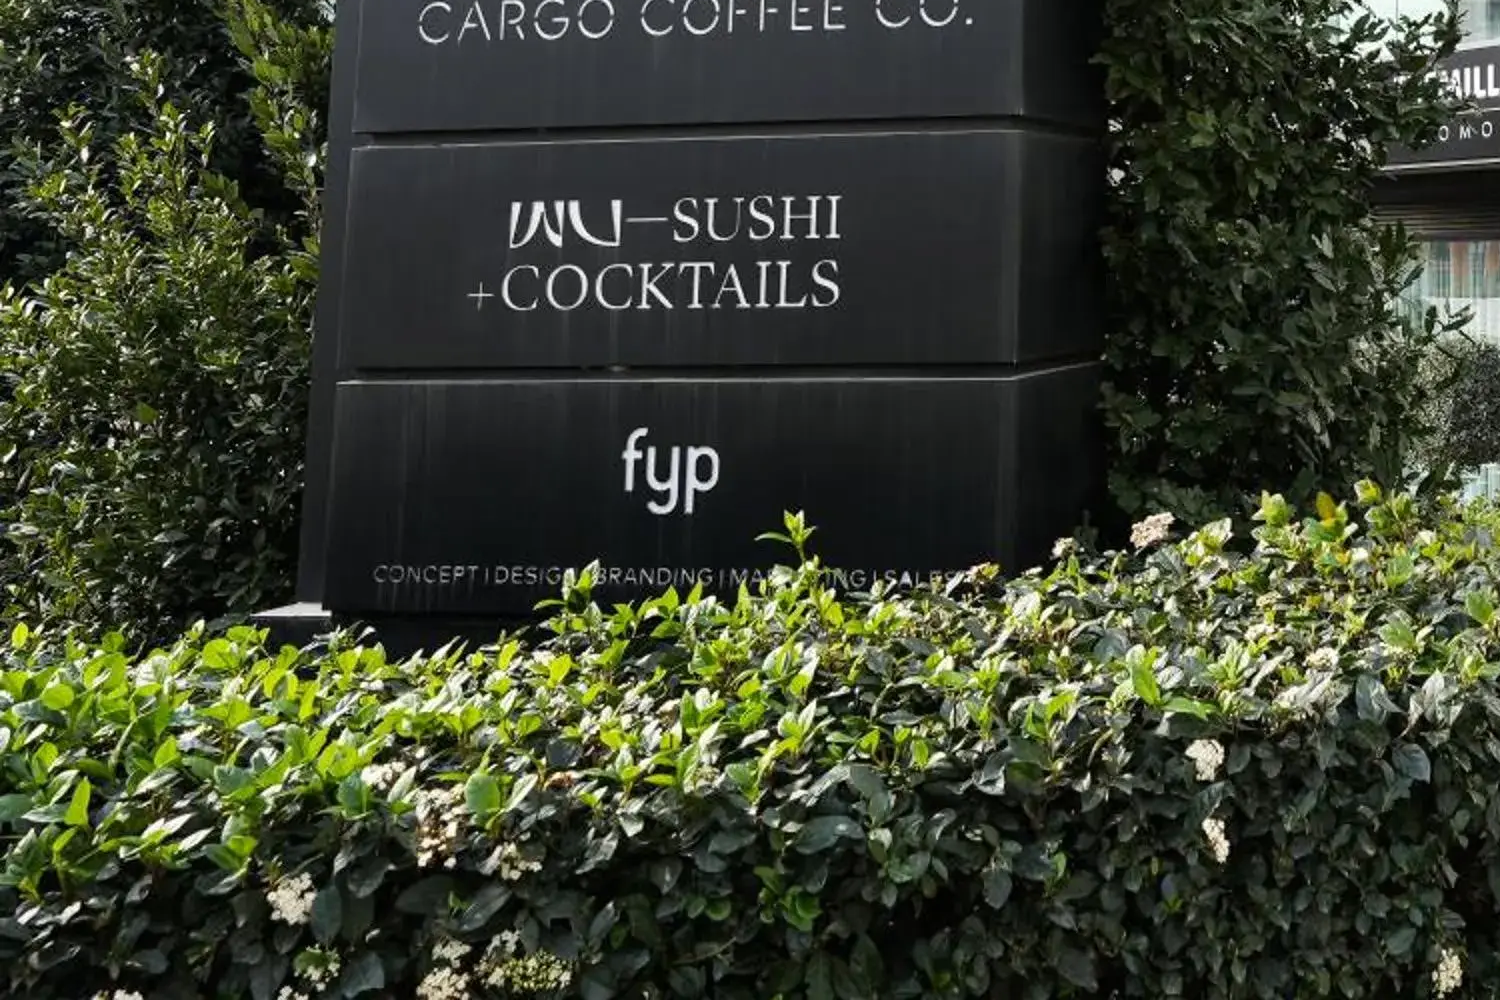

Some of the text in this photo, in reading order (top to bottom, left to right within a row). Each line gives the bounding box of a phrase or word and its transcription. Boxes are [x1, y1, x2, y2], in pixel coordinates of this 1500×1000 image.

[621, 427, 720, 515] fyp
[373, 565, 479, 584] CONCEPT
[495, 566, 579, 585] DESIG
